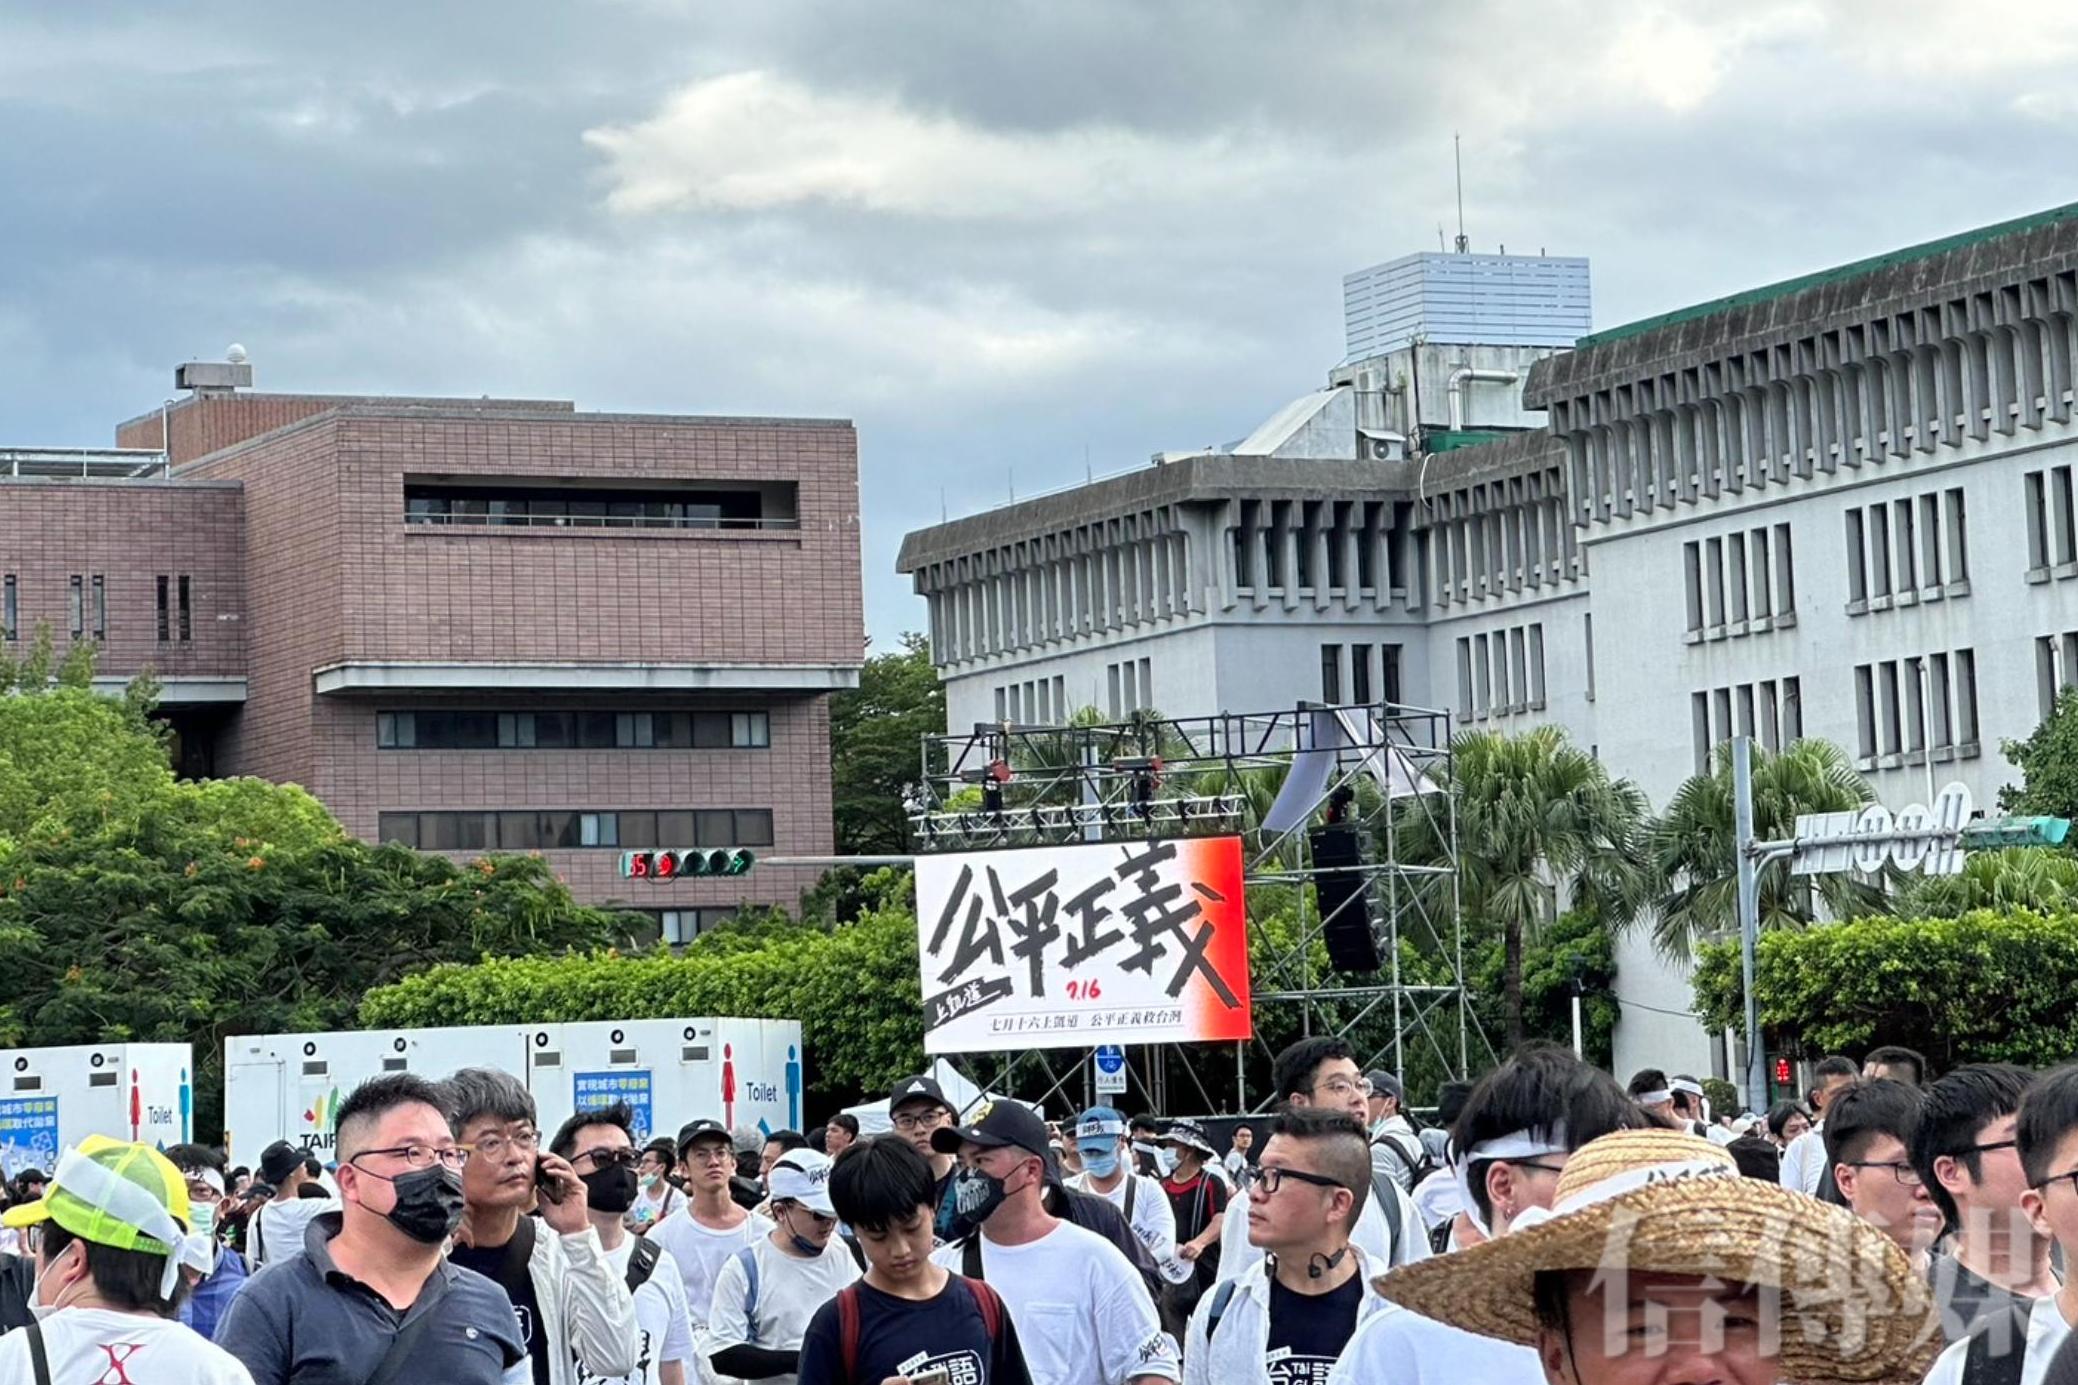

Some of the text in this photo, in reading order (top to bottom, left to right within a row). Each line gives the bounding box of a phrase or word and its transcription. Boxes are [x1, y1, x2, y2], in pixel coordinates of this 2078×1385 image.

[927, 841, 1243, 1008] 公平正義
[1065, 978, 1102, 1001] 7.16
[991, 1009, 1183, 1032] 七月十六上凱道 公平正義救台灣
[746, 1082, 777, 1102] Toilet
[147, 1106, 173, 1125] Toilet
